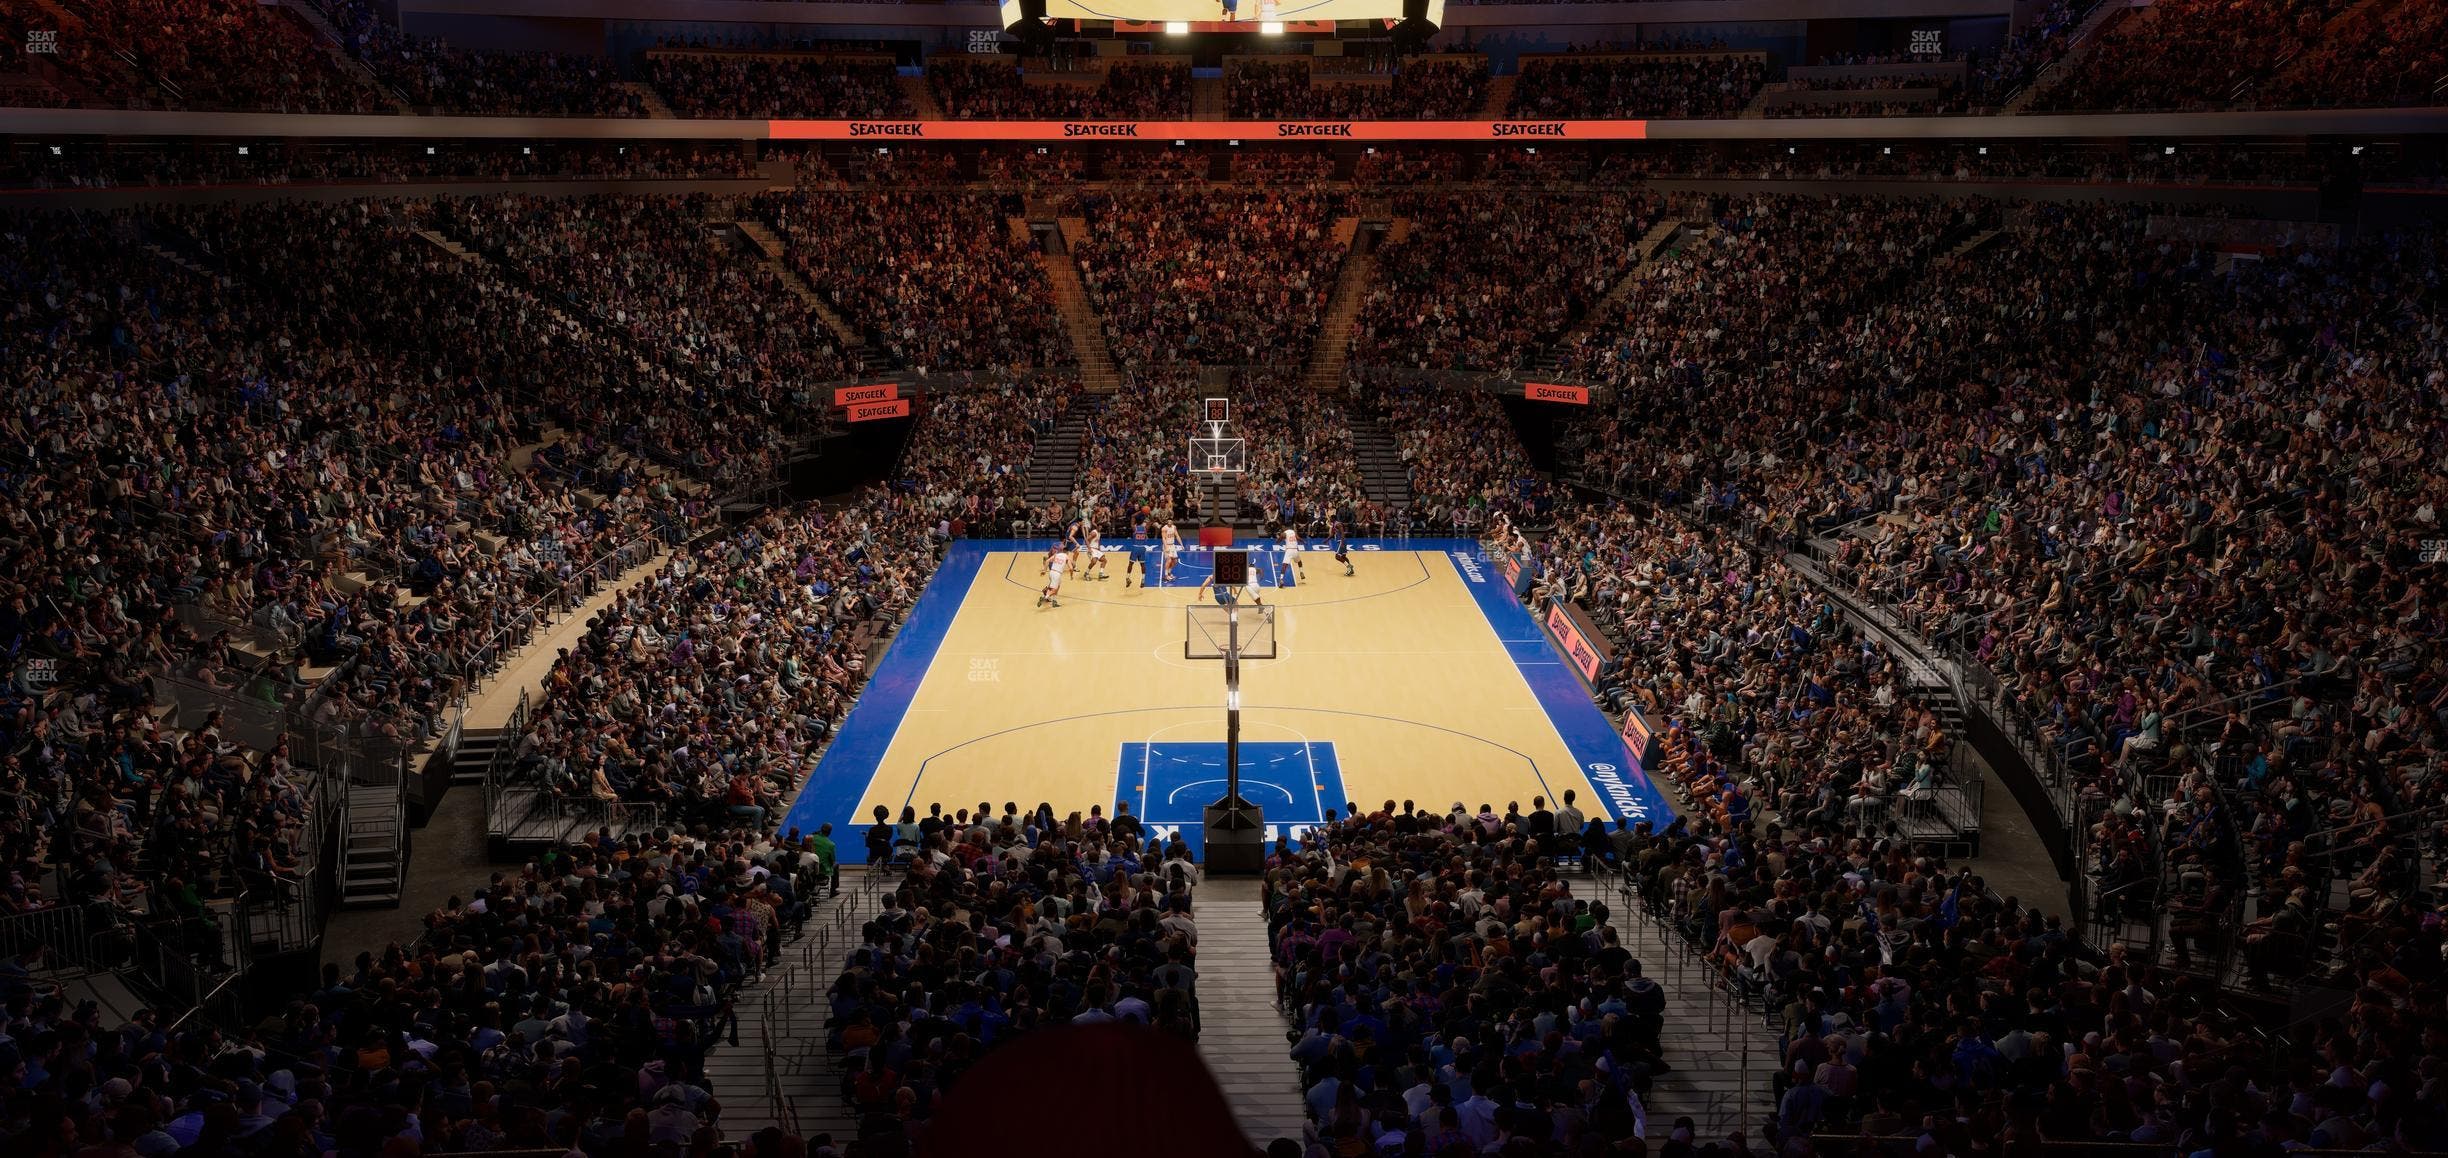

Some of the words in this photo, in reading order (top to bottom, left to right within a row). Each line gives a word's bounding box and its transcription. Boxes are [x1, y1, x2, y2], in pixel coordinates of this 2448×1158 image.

[850, 123, 923, 136] SEATGEEK
[1064, 123, 1137, 136] SEATGEEK
[1279, 123, 1352, 136] SEATGEEK
[1493, 123, 1566, 136] SEATGEEK
[846, 388, 887, 402] SEATGEEK
[1536, 388, 1577, 401] SEATGEEK
[857, 405, 899, 418] SEATGEEK
[1572, 639, 1594, 675] SEATGEEK
[1624, 720, 1646, 752] SEATGEEK
[1588, 763, 1648, 818] @nyknicks
